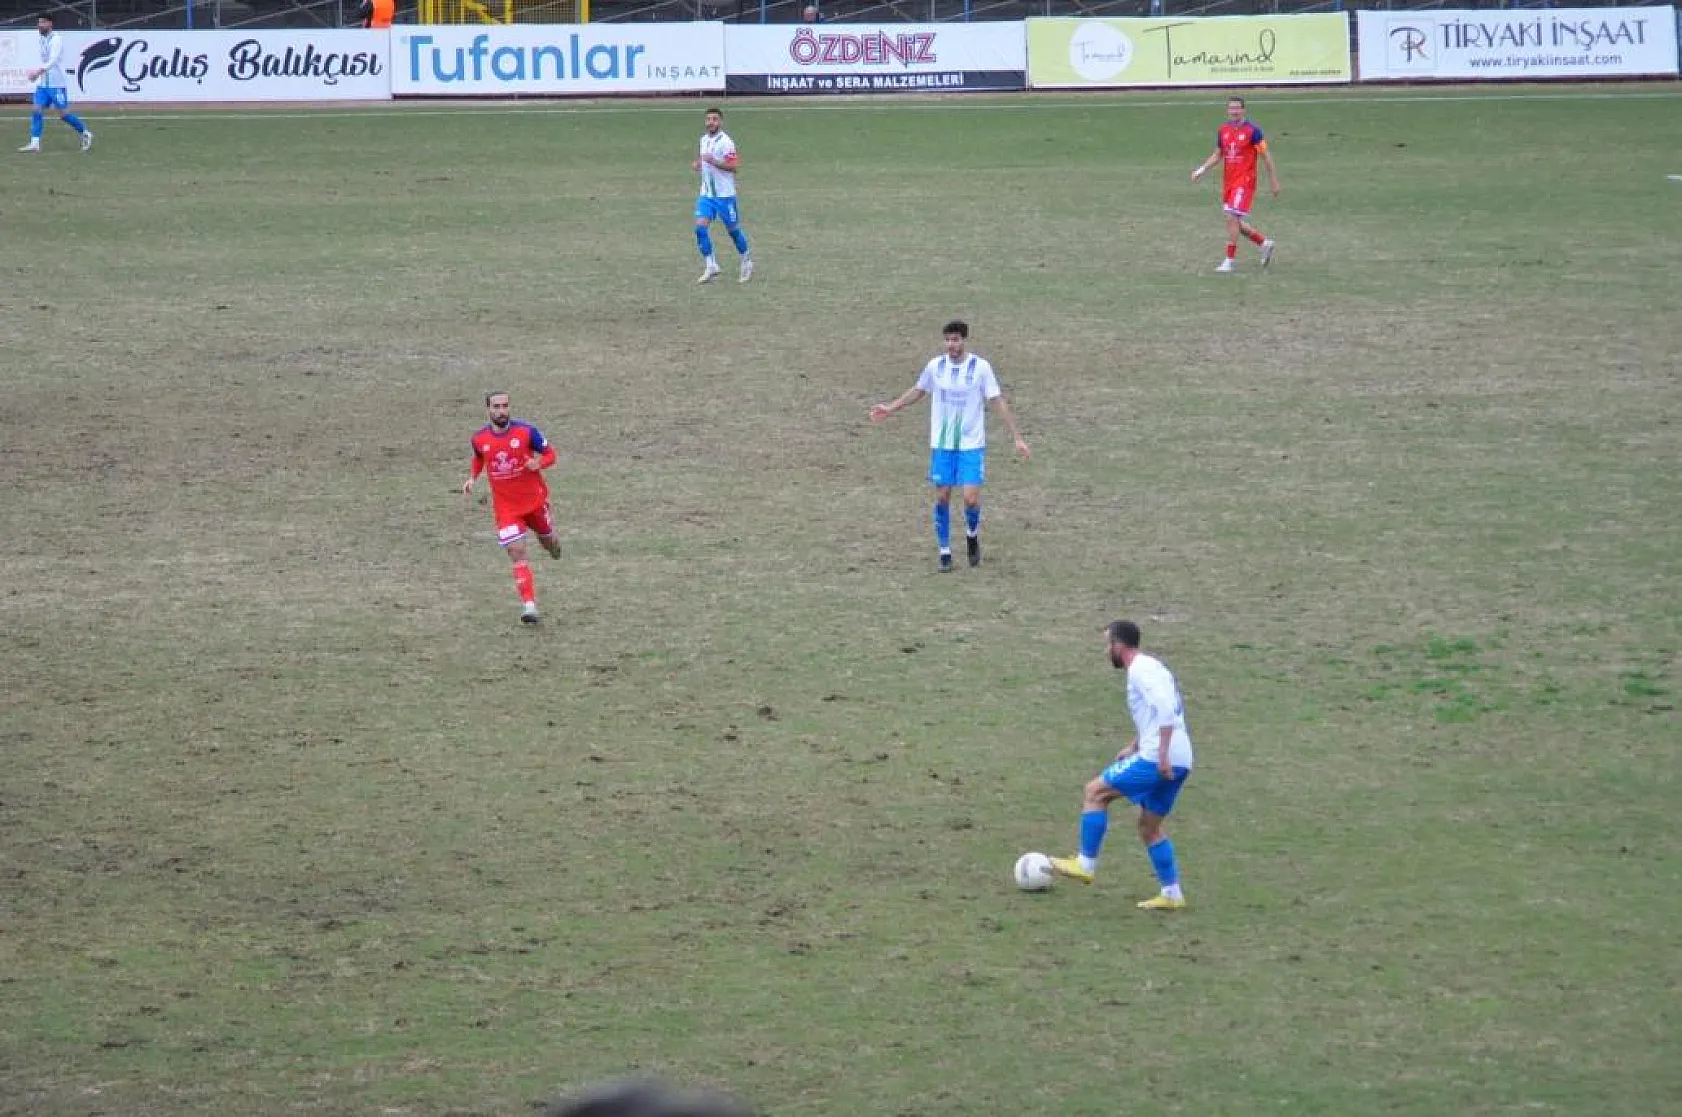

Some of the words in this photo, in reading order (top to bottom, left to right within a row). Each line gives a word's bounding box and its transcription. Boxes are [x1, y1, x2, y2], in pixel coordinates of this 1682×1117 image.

[1142, 22, 1276, 78] Tamarind
[1439, 16, 1542, 49] TİRYAKİ
[1552, 15, 1649, 50] İNŞAAT
[118, 39, 209, 92] Çalış
[228, 38, 382, 85] Balıkçısı
[408, 33, 646, 83] Tufanlar
[1468, 52, 1623, 69] www.tiryakiinsaat.com
[768, 73, 815, 91] İNŞAAT
[818, 79, 832, 89] ve
[836, 77, 870, 89] SERA
[873, 71, 965, 88] MALZEMELERİ
